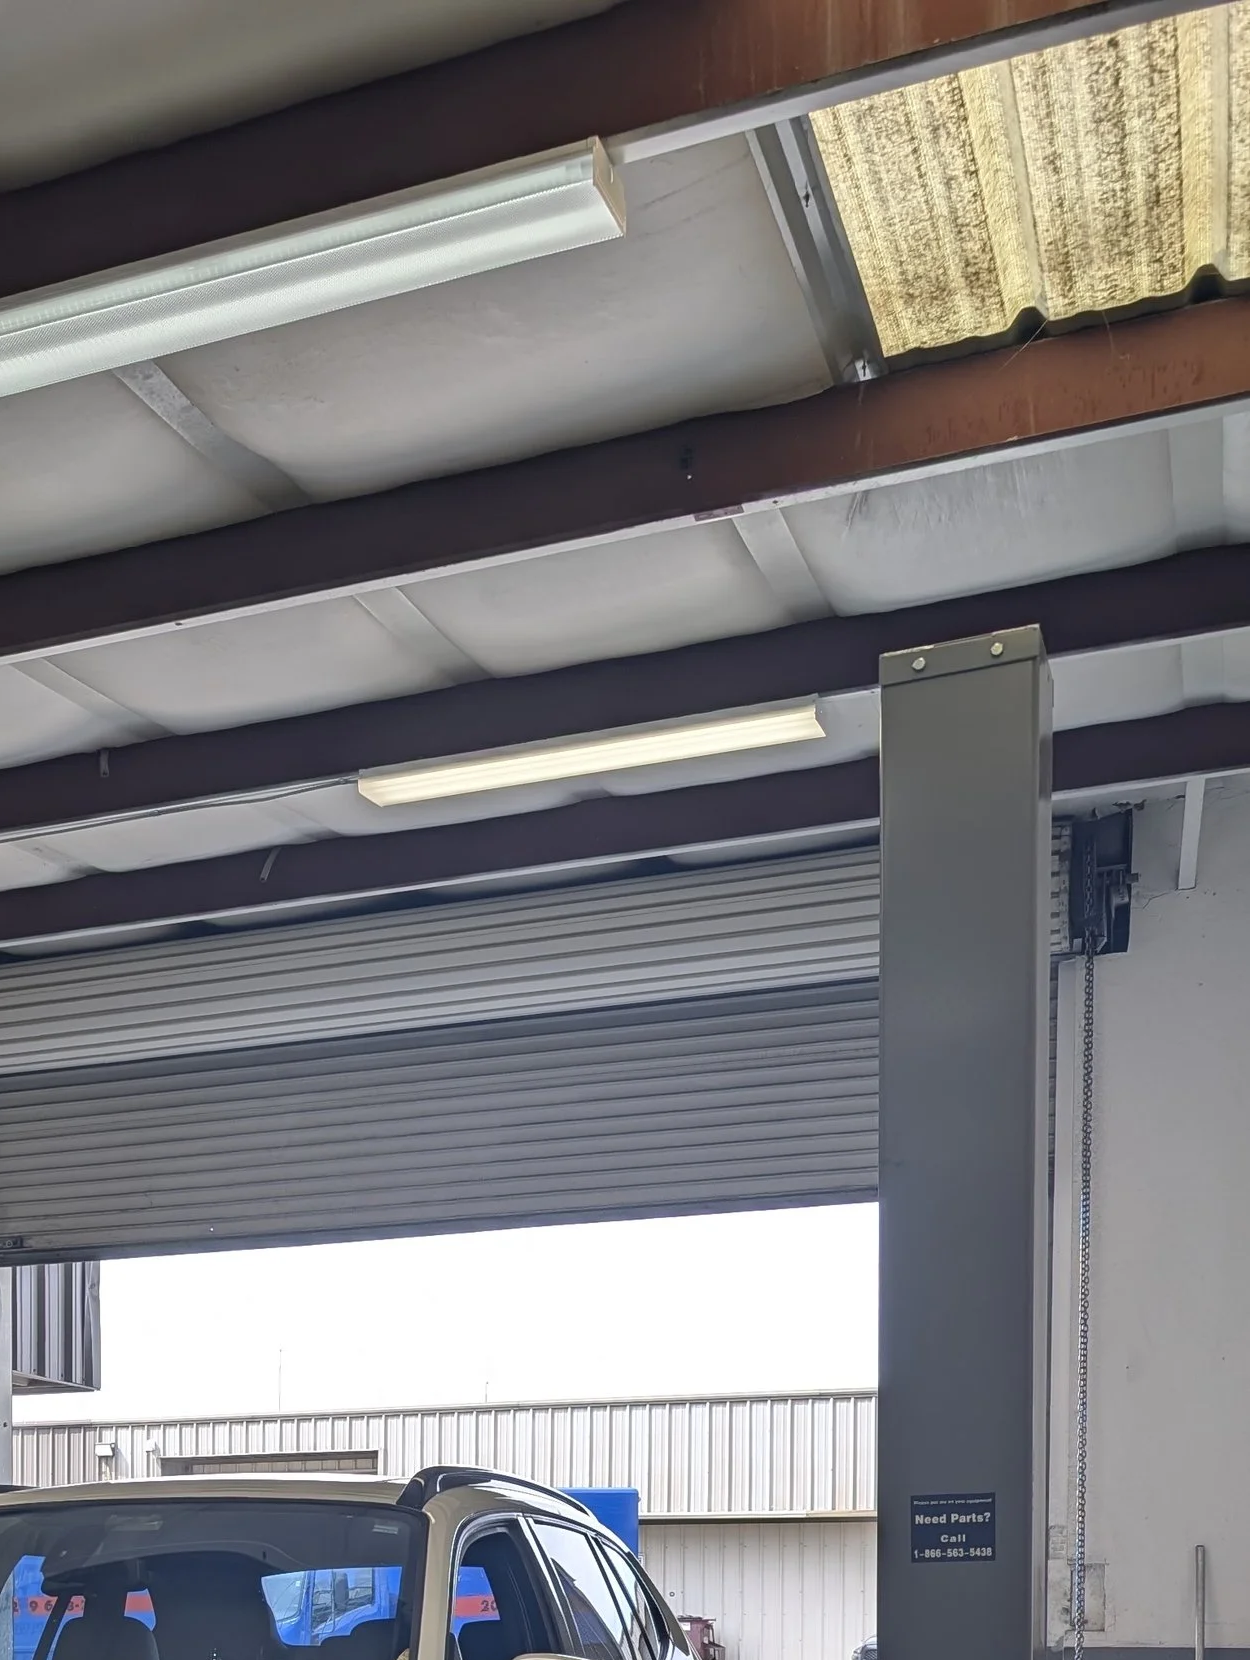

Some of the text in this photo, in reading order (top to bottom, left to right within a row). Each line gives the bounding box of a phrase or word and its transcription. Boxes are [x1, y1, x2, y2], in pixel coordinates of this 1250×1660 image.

[914, 1512, 991, 1524] Need Parts?
[940, 1534, 966, 1543] Call
